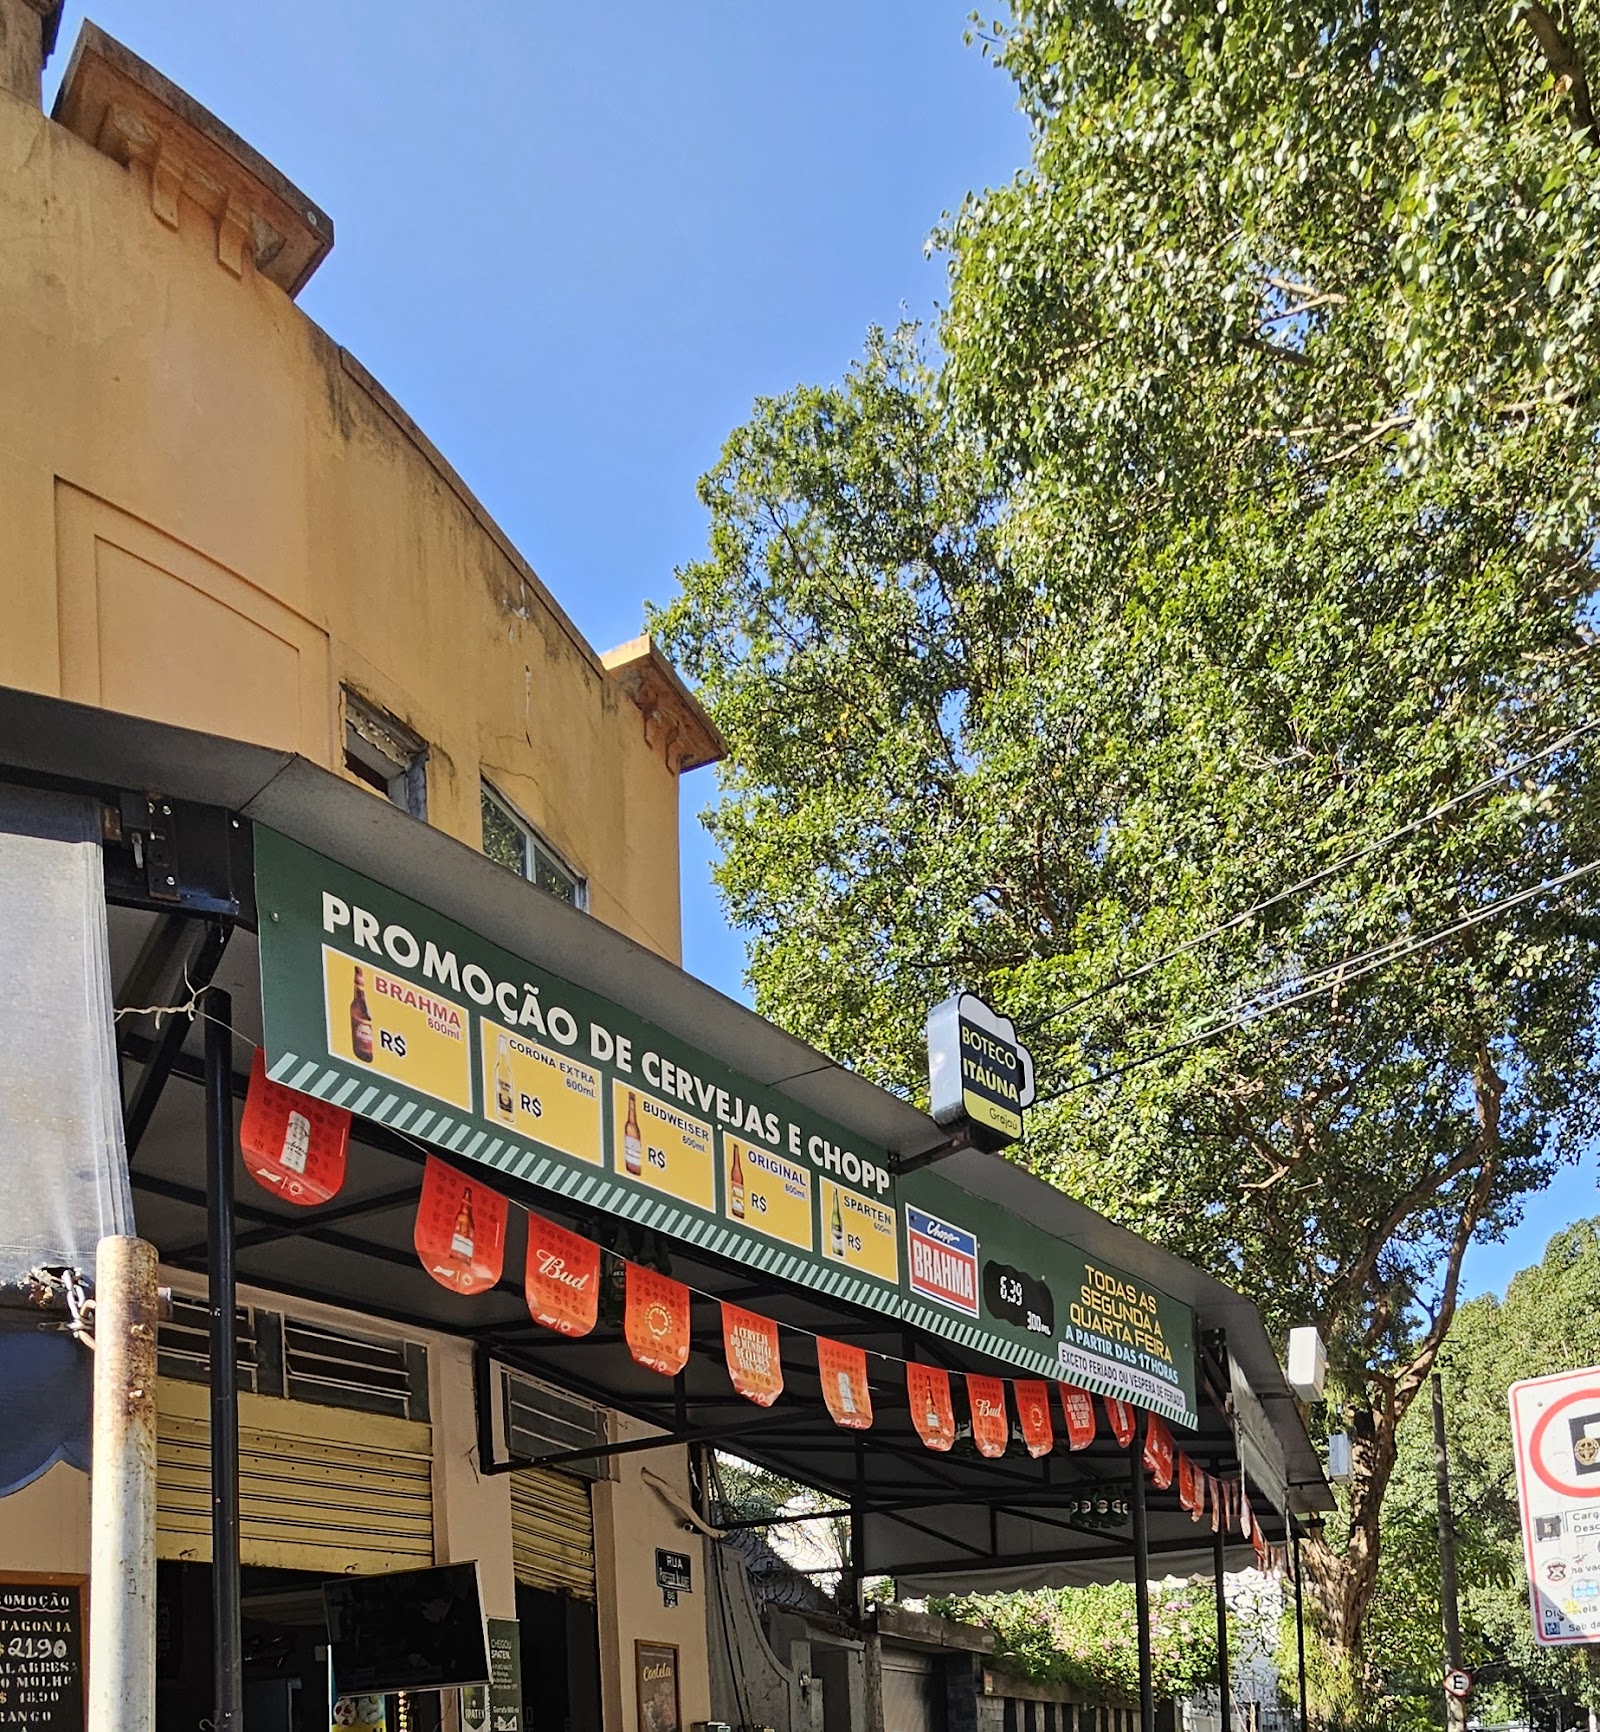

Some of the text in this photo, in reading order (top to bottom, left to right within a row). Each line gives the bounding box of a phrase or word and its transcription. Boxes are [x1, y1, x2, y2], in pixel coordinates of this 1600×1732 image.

[374, 975, 462, 1029] BRAHMA
[322, 890, 890, 1195] PROMOÇÃO DE CERVEJAS E CHOPP
[379, 1029, 407, 1057] R$
[961, 1025, 1017, 1070] BOTECO
[509, 1039, 596, 1085] CORONA EXTRA
[963, 1057, 1019, 1103] ITAÚNA
[520, 1093, 542, 1118] R$
[642, 1100, 710, 1142] BUDWEISER
[989, 1107, 1018, 1131] Grajaú
[647, 1147, 666, 1169] R$
[748, 1150, 807, 1187] ORIGINAL
[751, 1192, 767, 1213] R$
[843, 1195, 892, 1225] SPARTEN
[847, 1233, 862, 1251] R$
[926, 1220, 960, 1244] Chopp
[535, 1248, 591, 1291] Bud
[912, 1238, 975, 1301] BRAHMA
[1084, 1264, 1157, 1315] TODAS AS
[1080, 1285, 1163, 1339] SEGUNDA A
[1064, 1324, 1075, 1342] A
[1075, 1328, 1114, 1357] PARTIR
[1115, 1343, 1137, 1365] DAS
[1069, 1302, 1174, 1364] QUARTA FEIRA
[1061, 1349, 1088, 1372] EXCETO
[1088, 1360, 1118, 1381] FERIADO
[1119, 1370, 1129, 1385] OU
[975, 1398, 1003, 1418] Bud
[666, 1555, 684, 1570] RUA
[0, 1592, 70, 1608] OMOÇÃO
[642, 1662, 673, 1682] Costela
[1453, 1674, 1463, 1690] E
